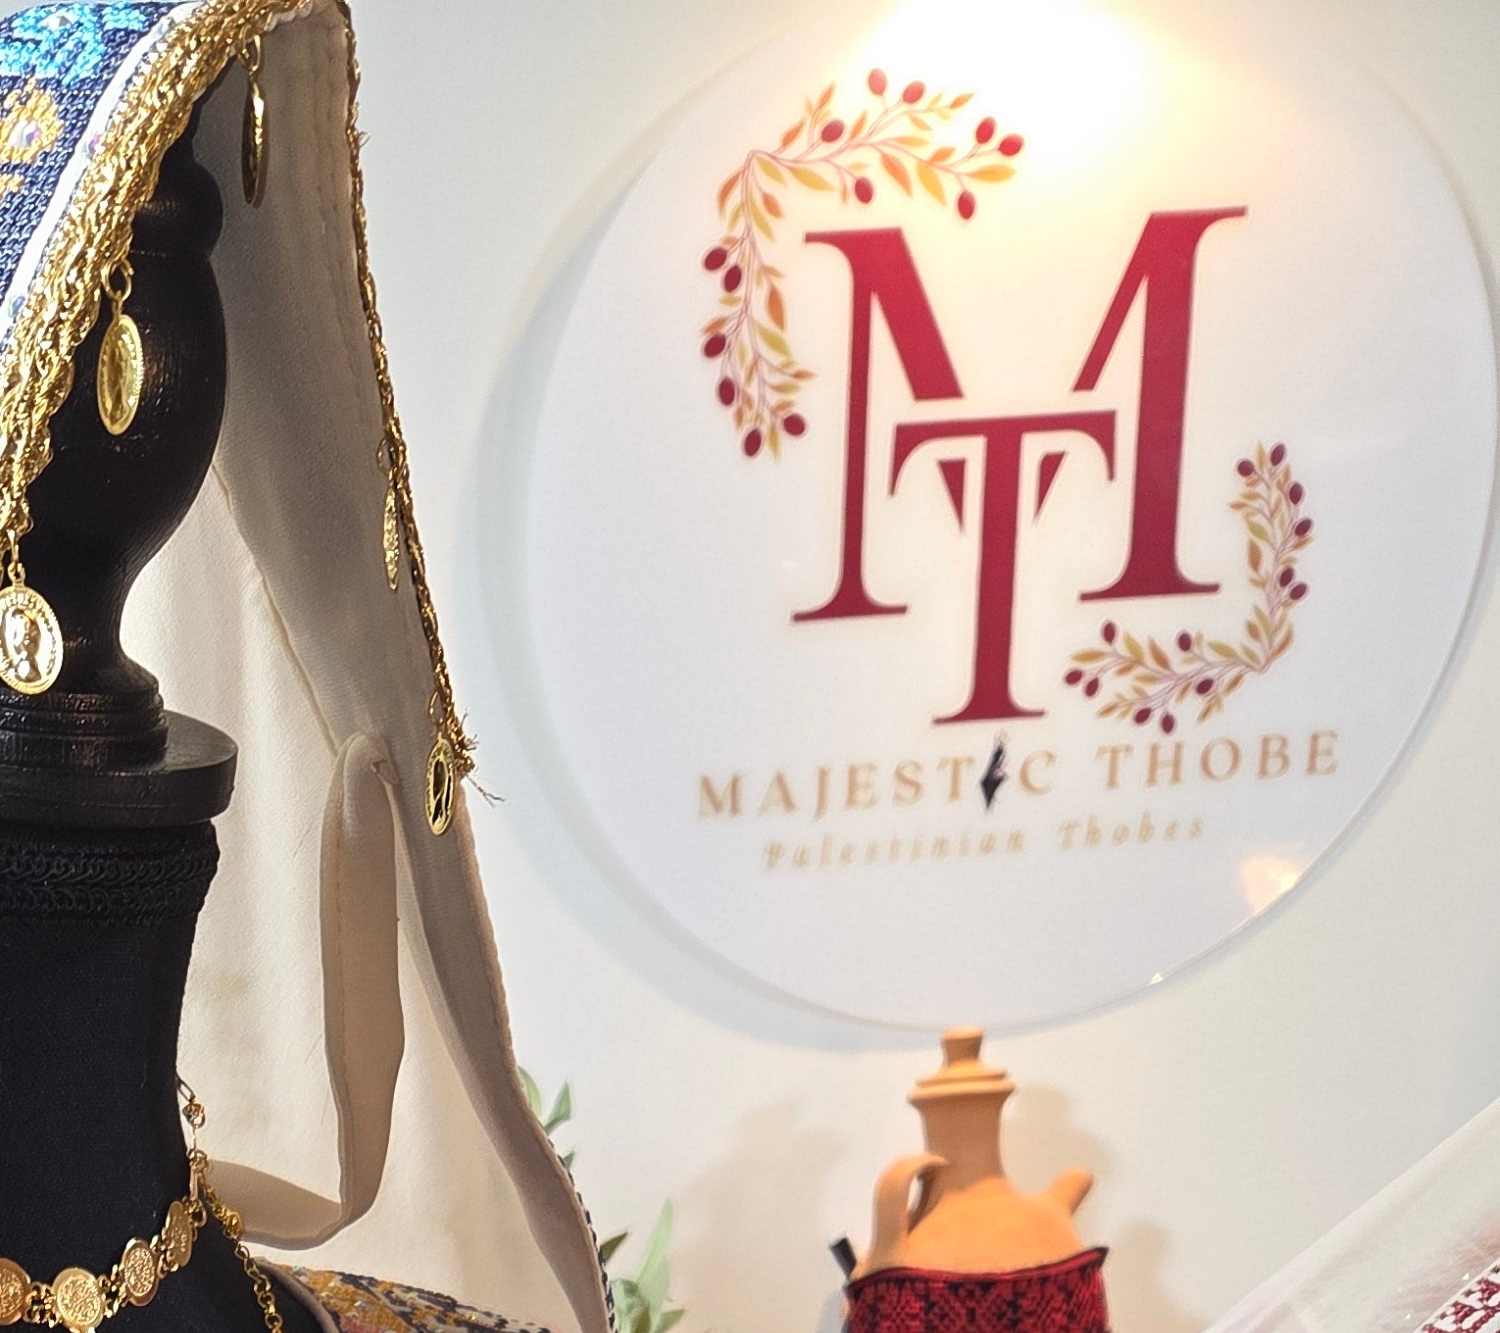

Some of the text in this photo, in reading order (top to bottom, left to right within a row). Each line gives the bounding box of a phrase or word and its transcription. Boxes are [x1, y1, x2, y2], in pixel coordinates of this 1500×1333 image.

[1093, 728, 1339, 791] THOBE
[763, 808, 1205, 871] Palestinian Thobes
